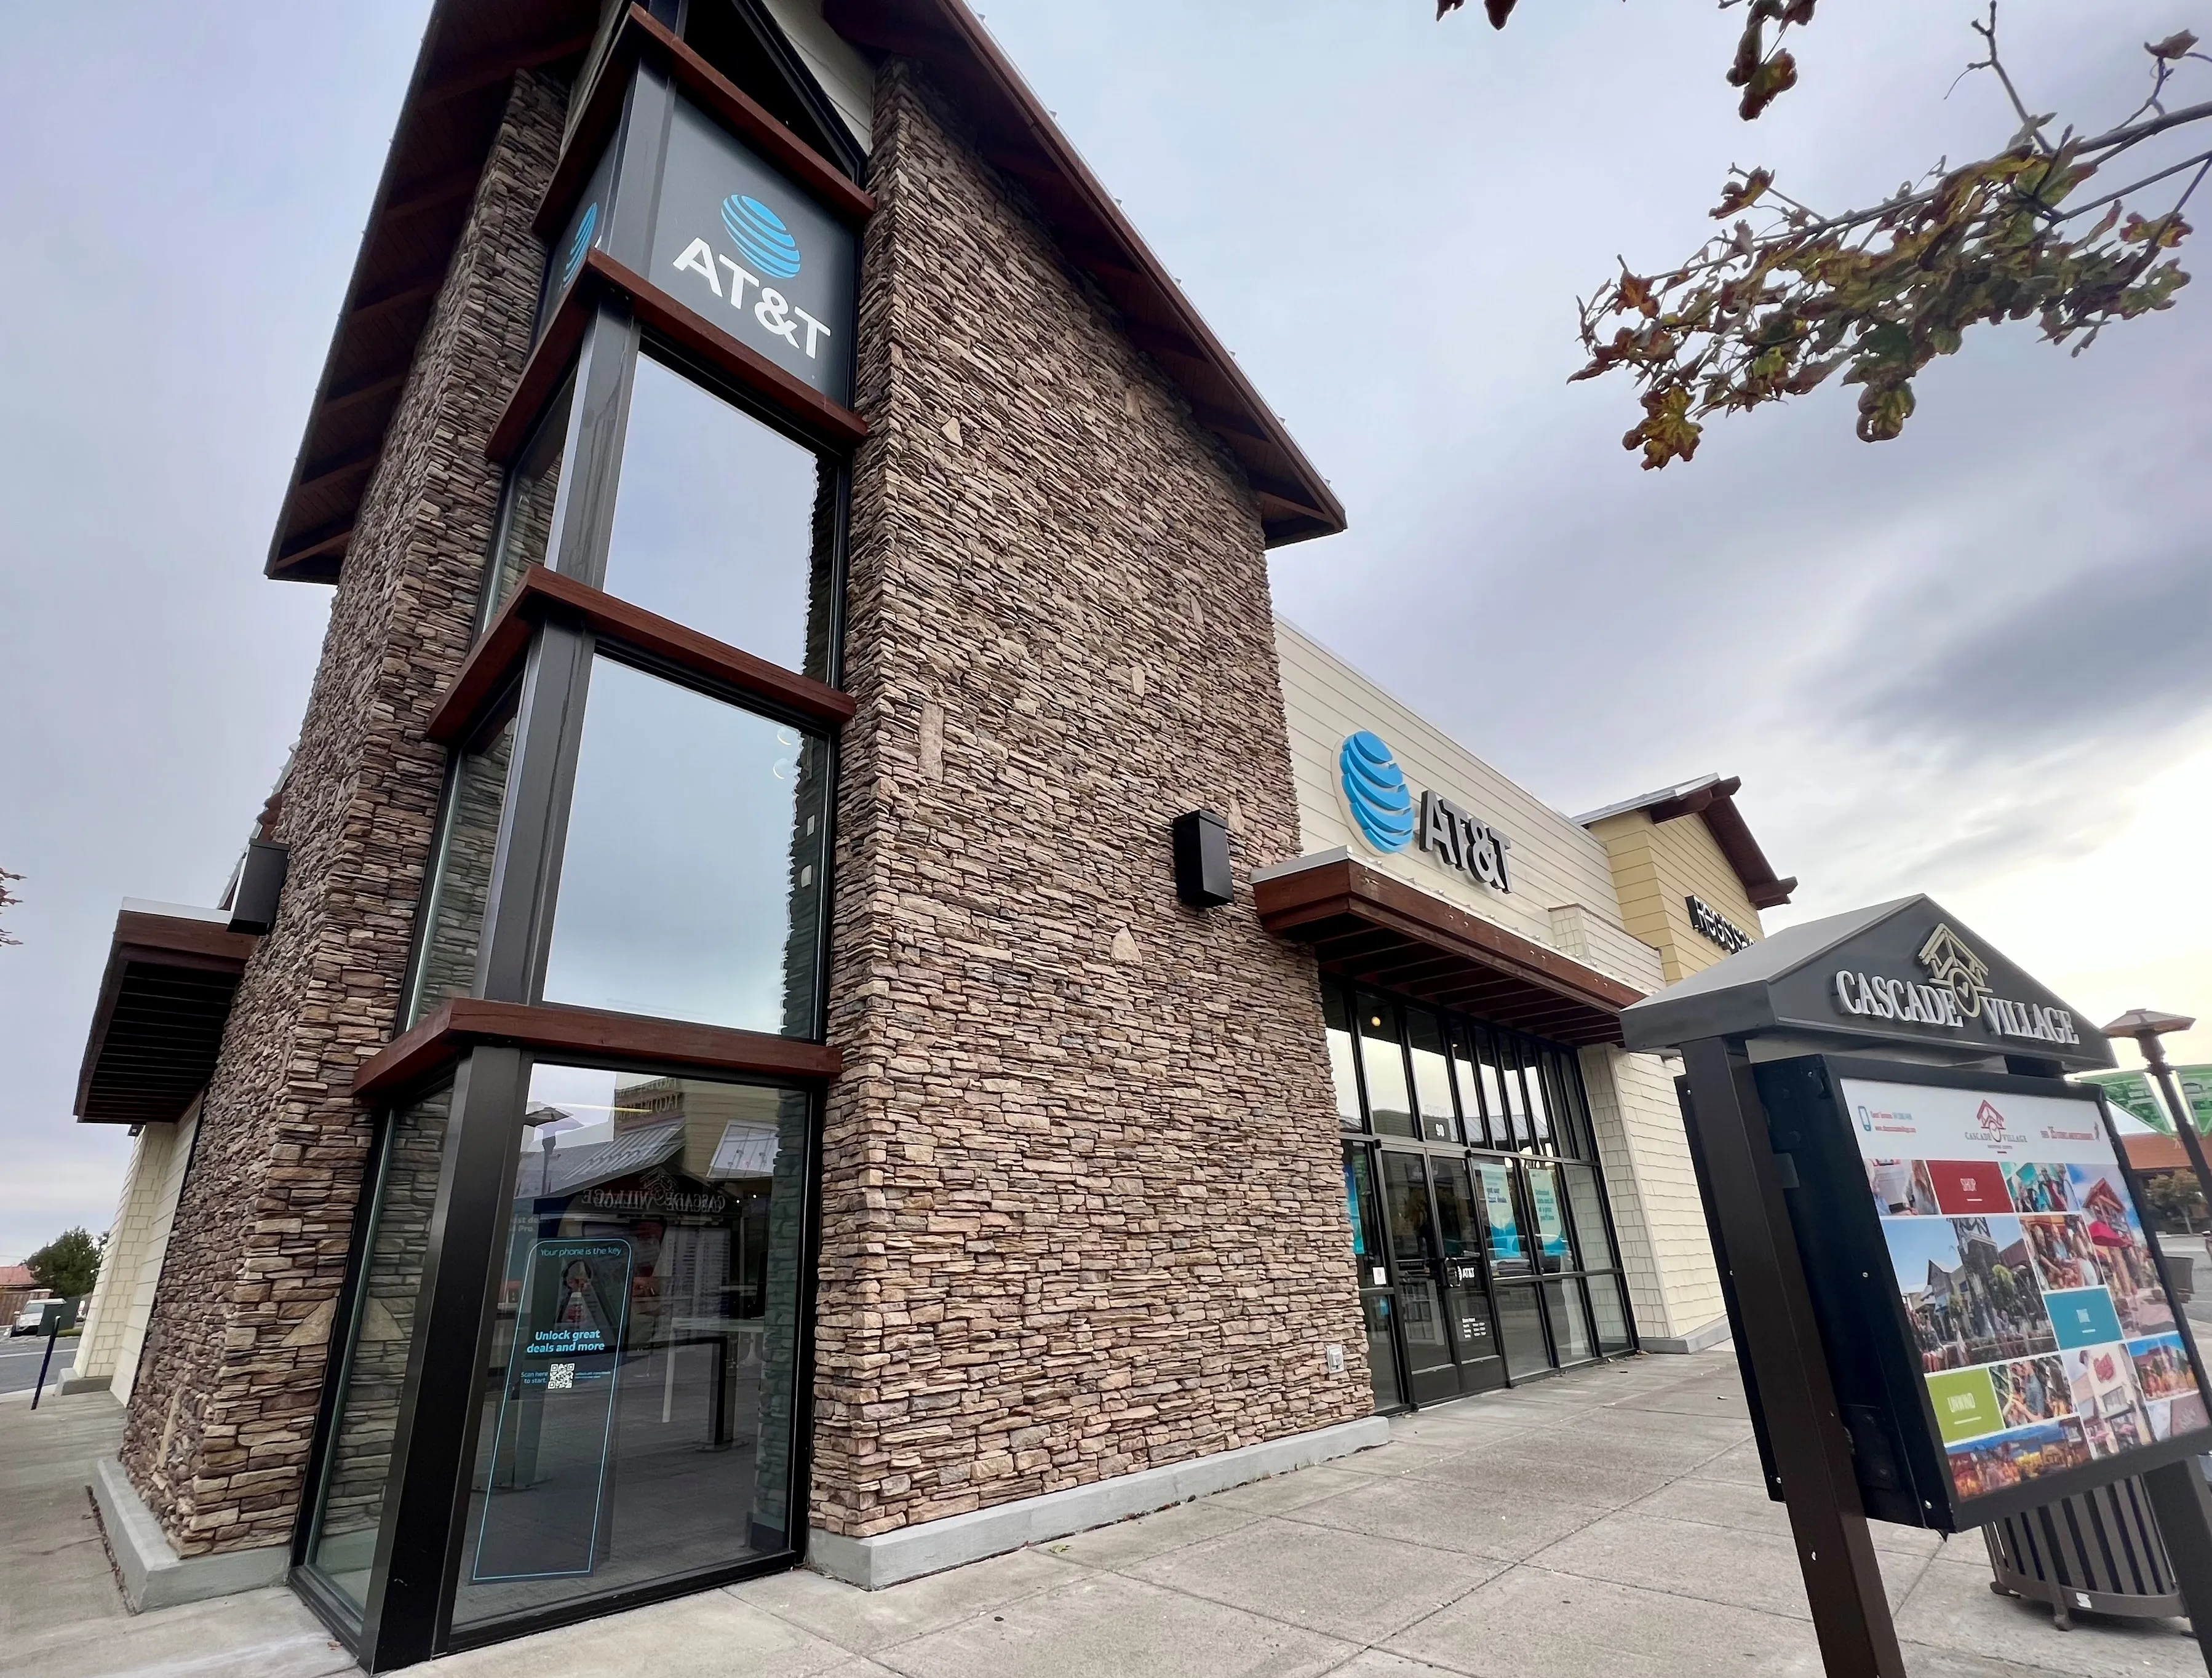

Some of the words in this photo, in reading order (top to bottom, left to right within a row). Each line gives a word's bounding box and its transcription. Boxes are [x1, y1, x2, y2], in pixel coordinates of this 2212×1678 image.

[672, 236, 832, 359] AT&T
[1419, 790, 1513, 894] AT&T
[1836, 970, 1964, 1028] CASCADE
[1979, 996, 2080, 1045] VILLAGE
[1434, 1123, 1446, 1137] 90
[559, 1248, 584, 1257] phone
[585, 1246, 591, 1255] is
[608, 1247, 622, 1256] key
[1462, 1267, 1475, 1279] AT&T
[535, 1330, 570, 1341] Unlock
[572, 1329, 600, 1342] great
[527, 1343, 554, 1353] deals
[555, 1342, 576, 1352] and
[578, 1342, 605, 1351] more
